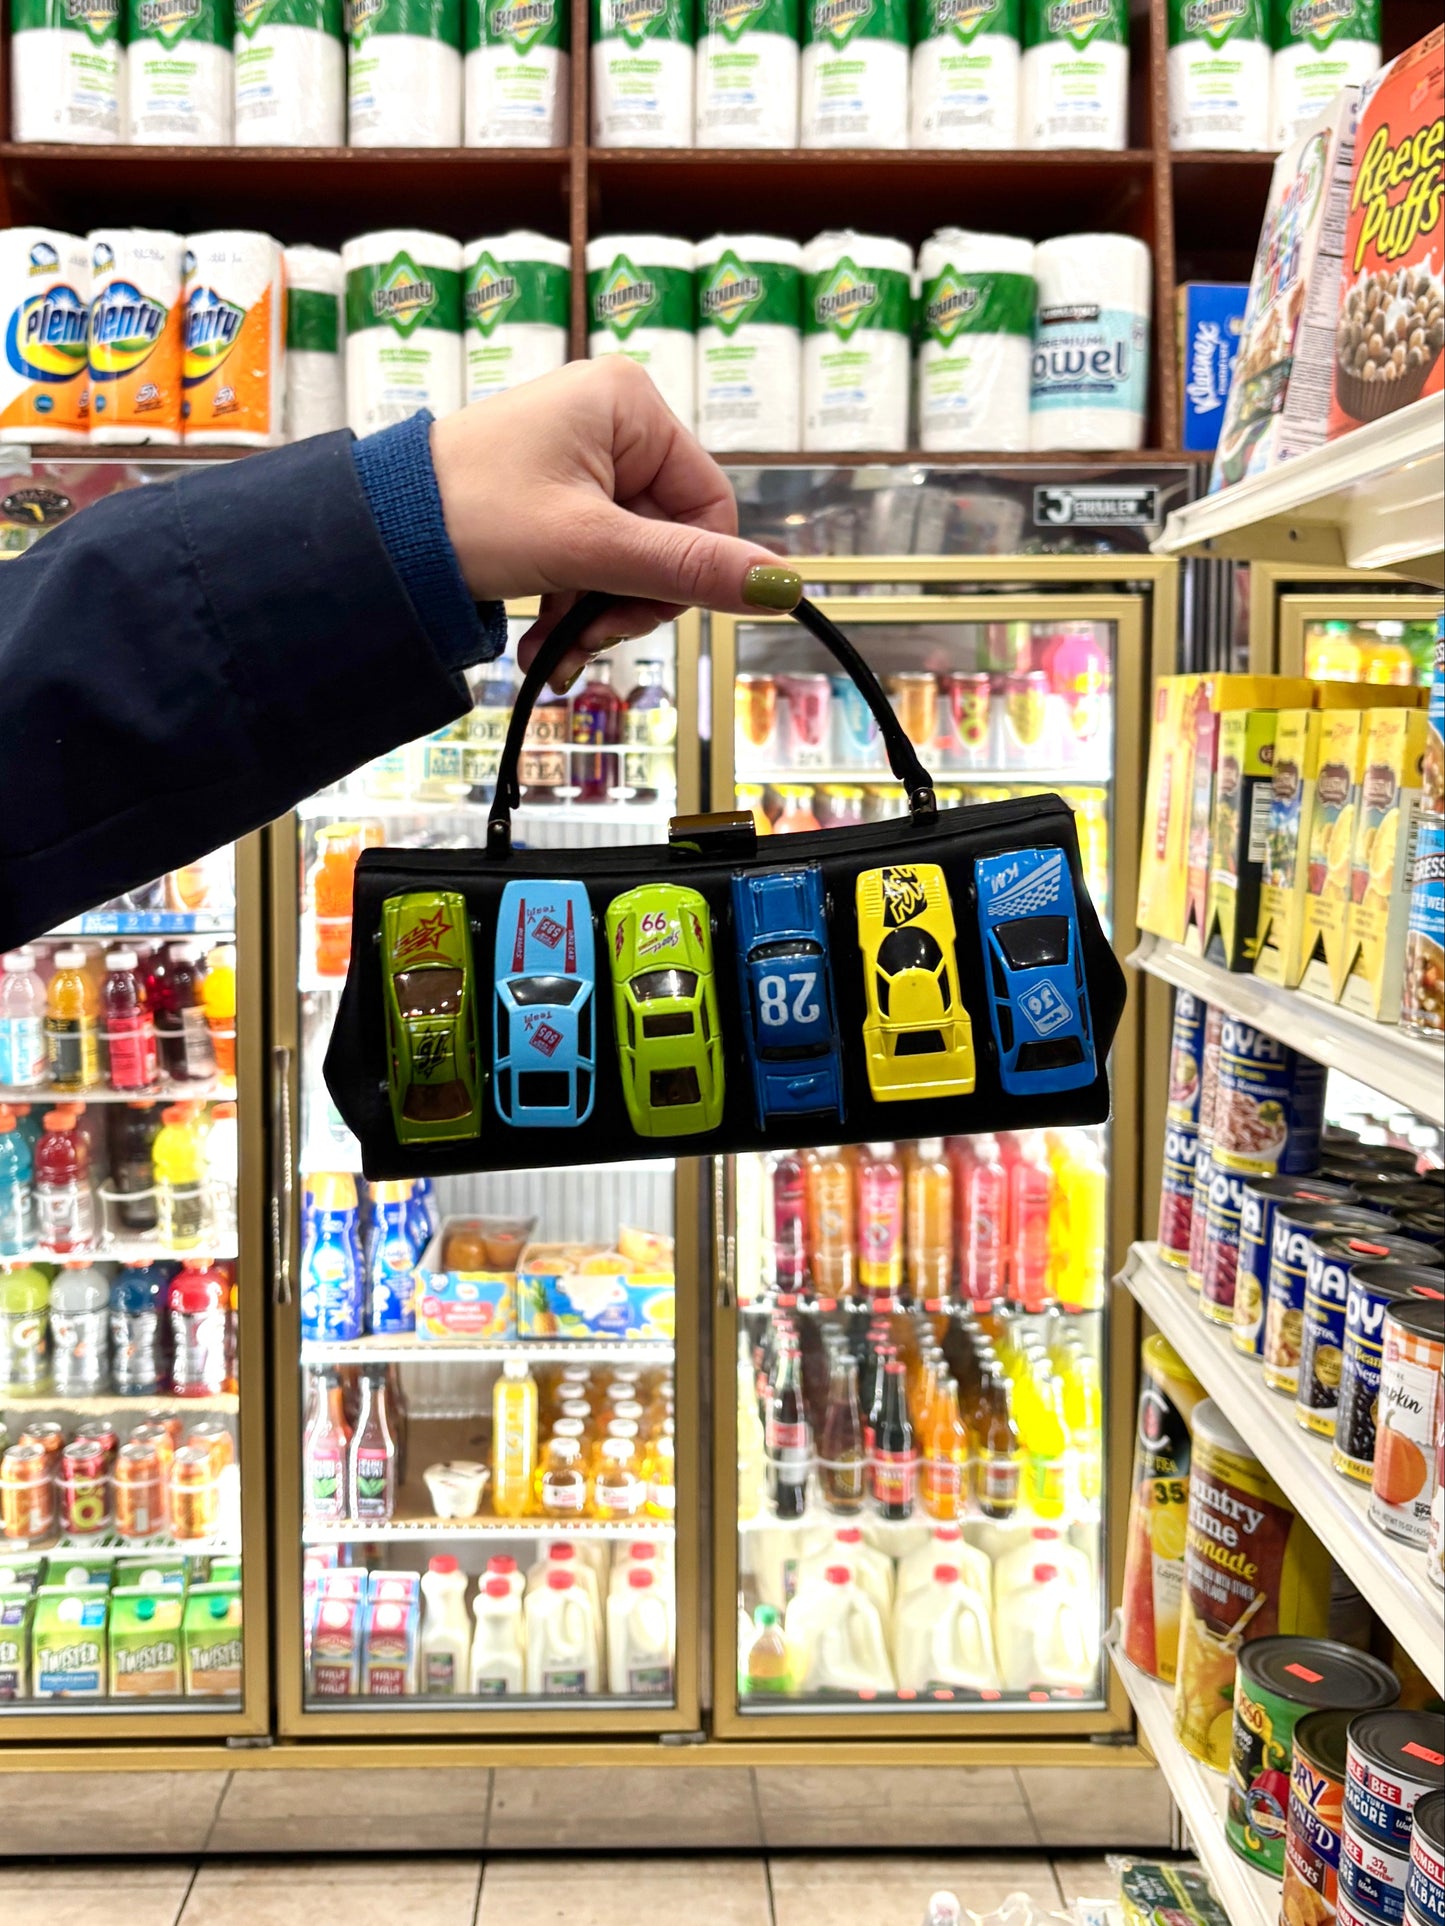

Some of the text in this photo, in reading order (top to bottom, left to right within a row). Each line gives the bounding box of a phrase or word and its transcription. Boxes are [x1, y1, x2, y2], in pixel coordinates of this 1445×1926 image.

[1350, 117, 1445, 213] Reese
[1353, 164, 1445, 274] Puffs
[374, 282, 434, 316] Bounty
[1032, 340, 1122, 379] owel
[1187, 321, 1221, 414] Kleenex
[524, 759, 565, 778] TEA
[1221, 1020, 1280, 1059] OYA
[1166, 1133, 1198, 1163] OY
[1210, 1174, 1244, 1209] OY
[1273, 1225, 1309, 1267] YA
[1308, 1257, 1346, 1300] YA
[1346, 1291, 1385, 1336] OY
[1355, 1347, 1382, 1369] Bean
[1154, 1481, 1186, 1505] 35
[1191, 1476, 1265, 1535] untry
[41, 1642, 99, 1674] TWISTER
[117, 1641, 175, 1674] TWISTER
[1371, 1778, 1397, 1802] BEE
[1290, 1793, 1335, 1851] ONED
[1349, 1793, 1389, 1830] ACORE
[1412, 1843, 1445, 1882] UMBL
[1410, 1880, 1445, 1918] ALBAC
[1428, 1879, 1445, 1899] WHI
